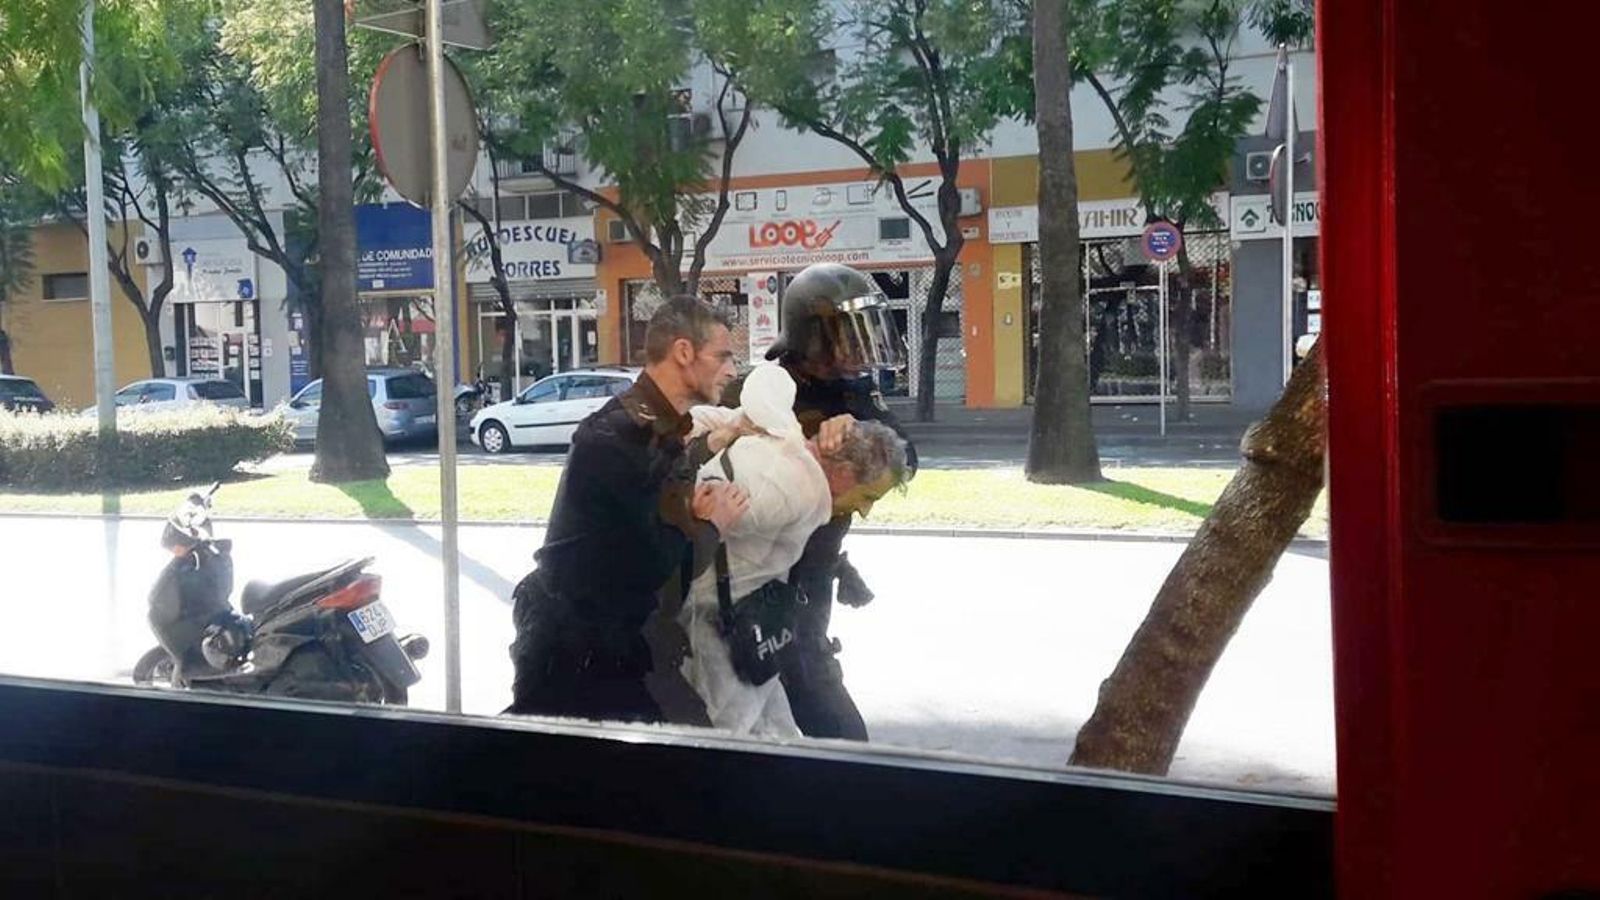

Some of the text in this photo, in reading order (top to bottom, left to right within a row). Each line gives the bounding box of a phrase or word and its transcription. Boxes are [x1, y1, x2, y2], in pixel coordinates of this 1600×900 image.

[748, 219, 818, 250] LOOP
[362, 250, 375, 262] DE
[721, 251, 870, 268] www.serviciotecnicoloop.com
[499, 260, 562, 278] ORRES
[757, 627, 793, 661] FILA
